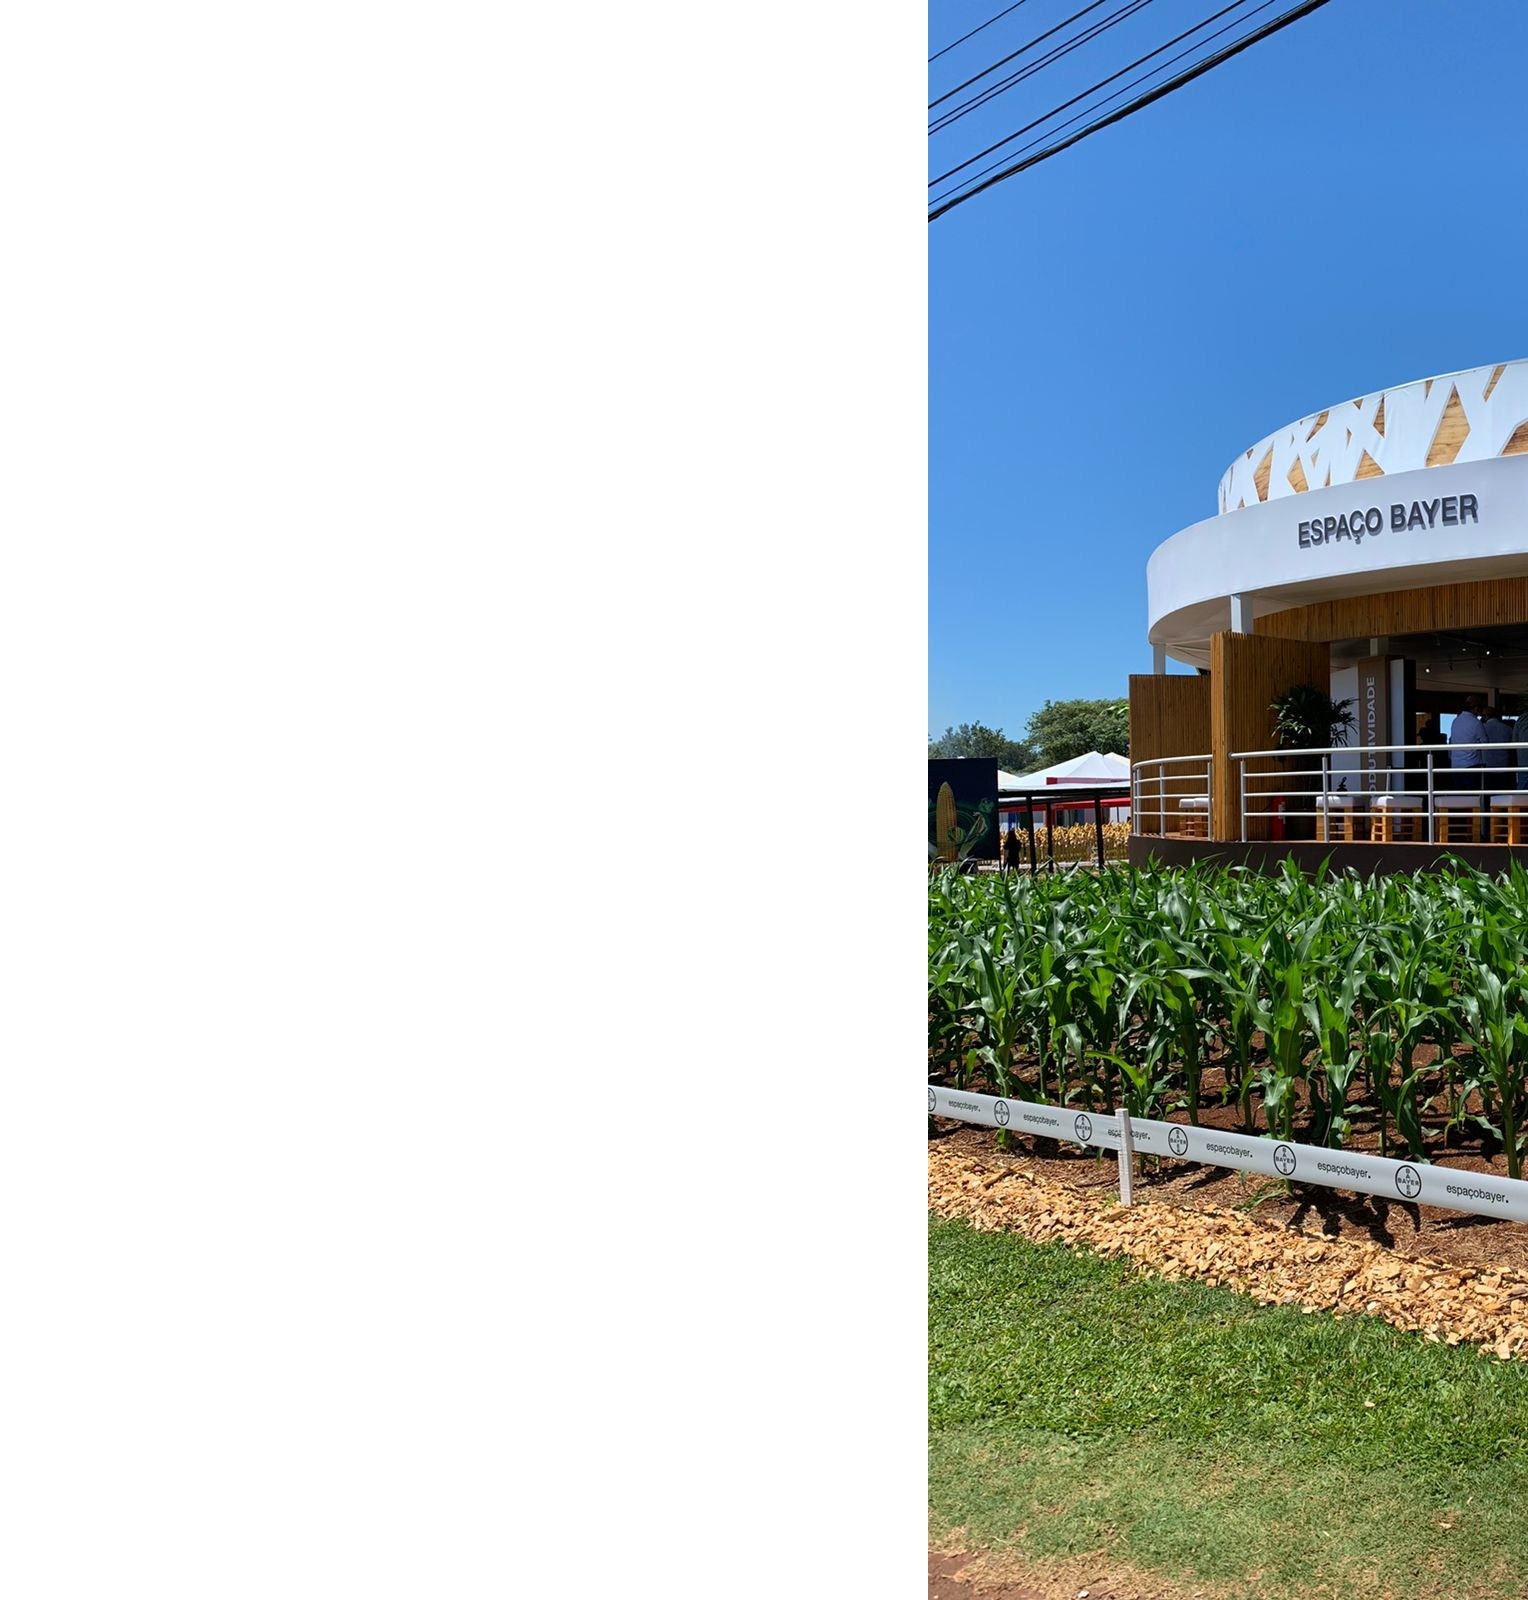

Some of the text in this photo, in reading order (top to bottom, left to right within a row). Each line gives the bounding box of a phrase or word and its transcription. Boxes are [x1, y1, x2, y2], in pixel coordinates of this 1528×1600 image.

[1298, 494, 1479, 547] ESPAÇO BAYER
[1366, 676, 1377, 796] ODUTIVIDADE
